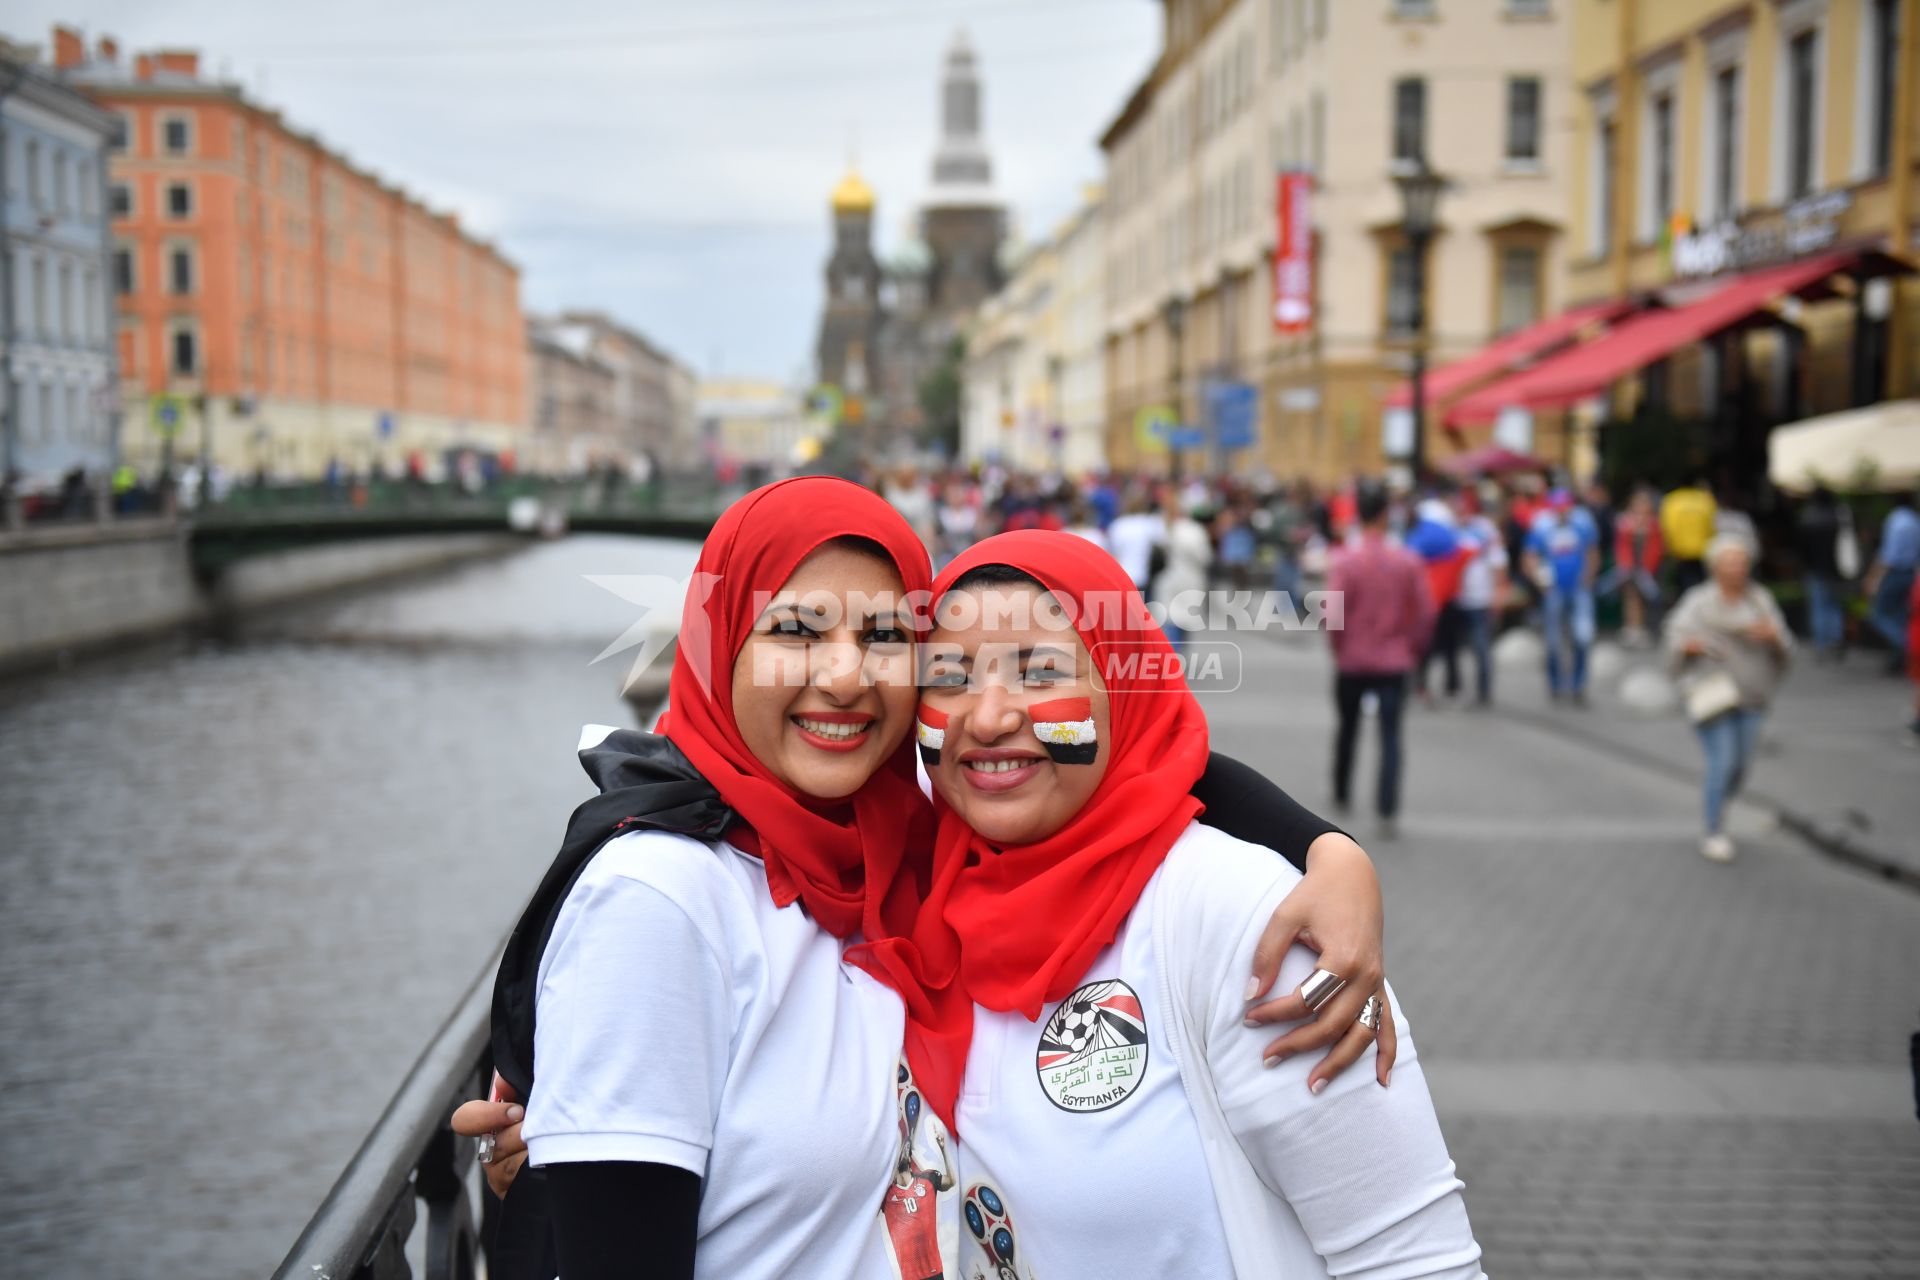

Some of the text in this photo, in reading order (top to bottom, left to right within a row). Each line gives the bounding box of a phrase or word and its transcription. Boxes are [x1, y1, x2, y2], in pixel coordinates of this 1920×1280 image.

[1051, 1046, 1139, 1085] الاتحاد المصري
[1060, 1063, 1133, 1099] لكرة القدم
[1062, 1085, 1127, 1107] EGYPTIAN FA
[903, 1197, 918, 1214] 10
